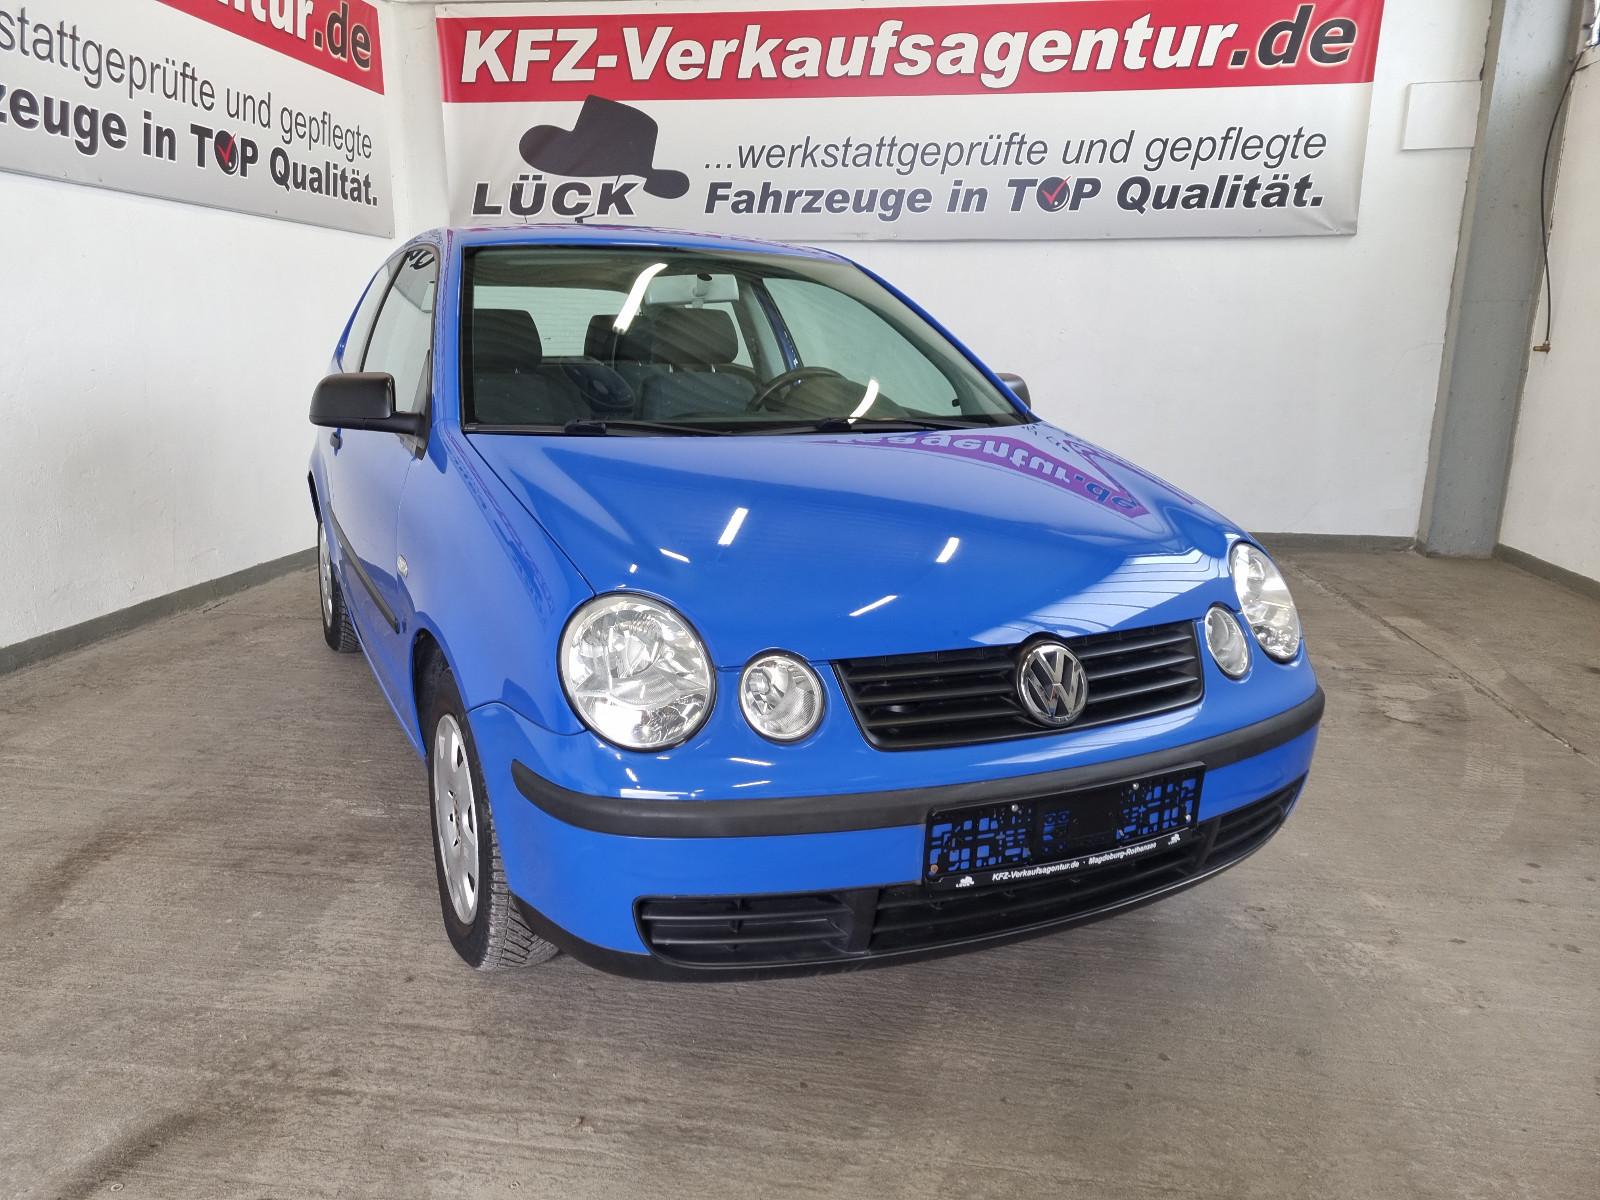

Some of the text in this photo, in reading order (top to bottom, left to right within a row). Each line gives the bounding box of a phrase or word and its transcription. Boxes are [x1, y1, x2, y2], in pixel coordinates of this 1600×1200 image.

[461, 4, 1357, 89] KFZ-Verkaufsagentur.de
[226, 87, 272, 129] und
[280, 108, 372, 163] gepflegte
[704, 126, 1327, 175] ...werkstattgeprüfte und gepflegte
[143, 110, 177, 162] in
[190, 122, 259, 178] TOP
[269, 146, 378, 206] Qualität.
[472, 175, 637, 216] LÜCK
[704, 174, 1324, 222] Fahrzeuge in TOP Qualität.
